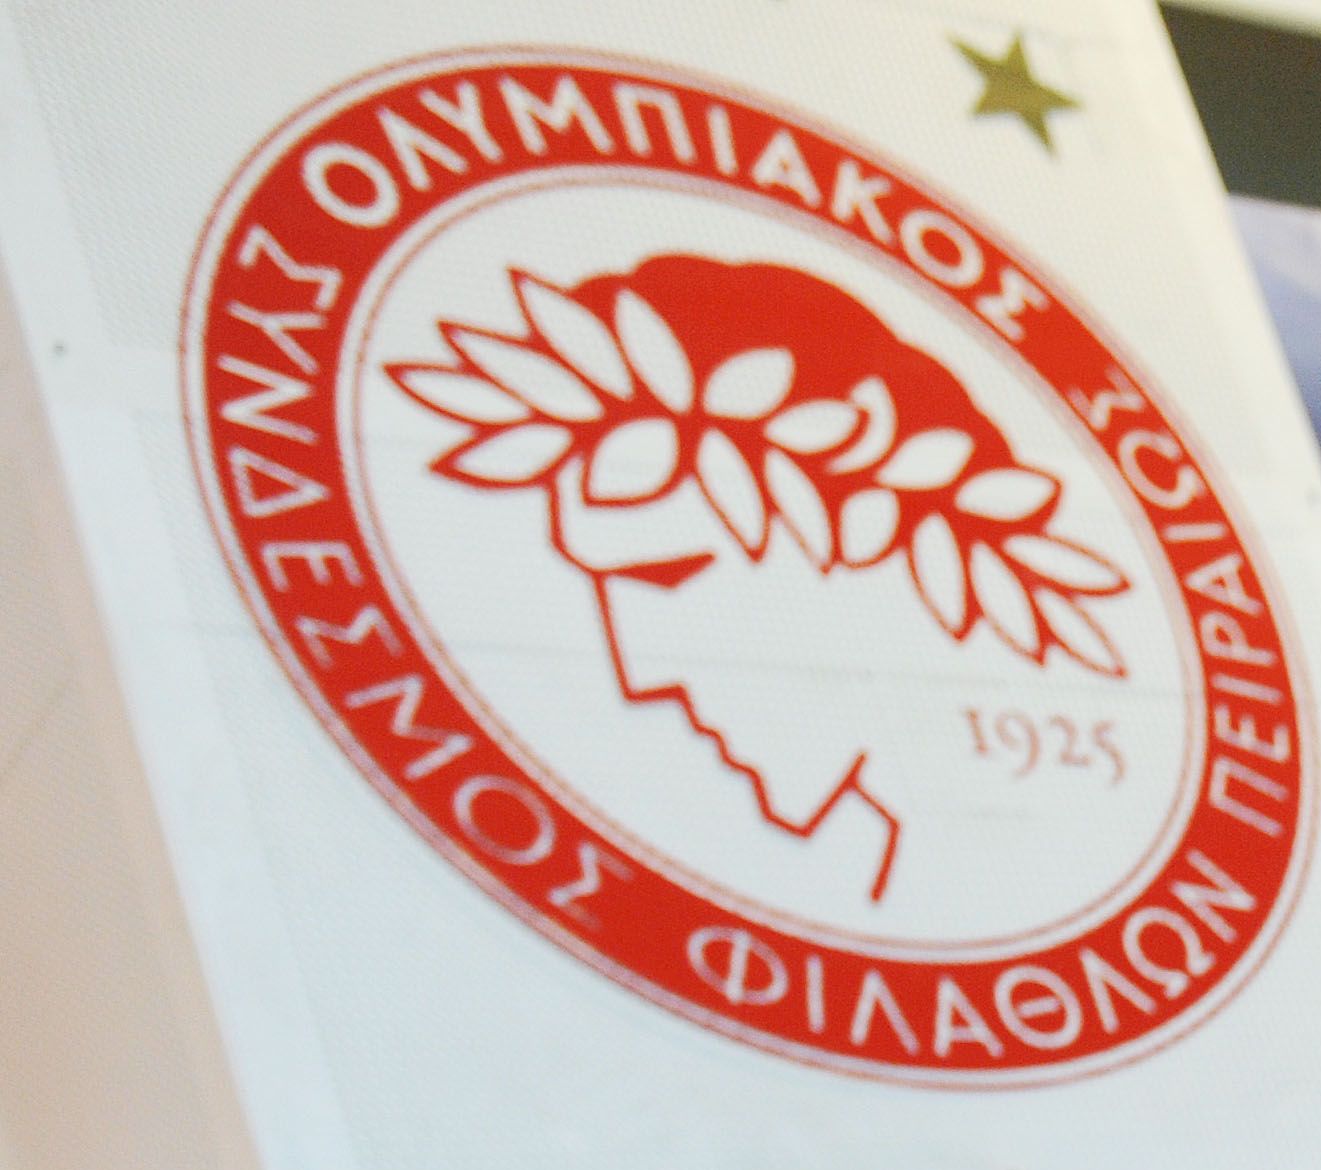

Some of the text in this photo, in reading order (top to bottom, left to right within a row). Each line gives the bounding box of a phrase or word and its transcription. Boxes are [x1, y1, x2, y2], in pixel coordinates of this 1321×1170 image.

[301, 74, 1049, 342] ΟΛΥΜΠΙΑΚΟΣ
[218, 224, 1292, 1058] ΣΥΝΔΕΣΜΟΣ ΦΙΛΑΘΛΩΝ ΠΕΙΡΑΙΩΣ
[963, 706, 1127, 784] 1925
